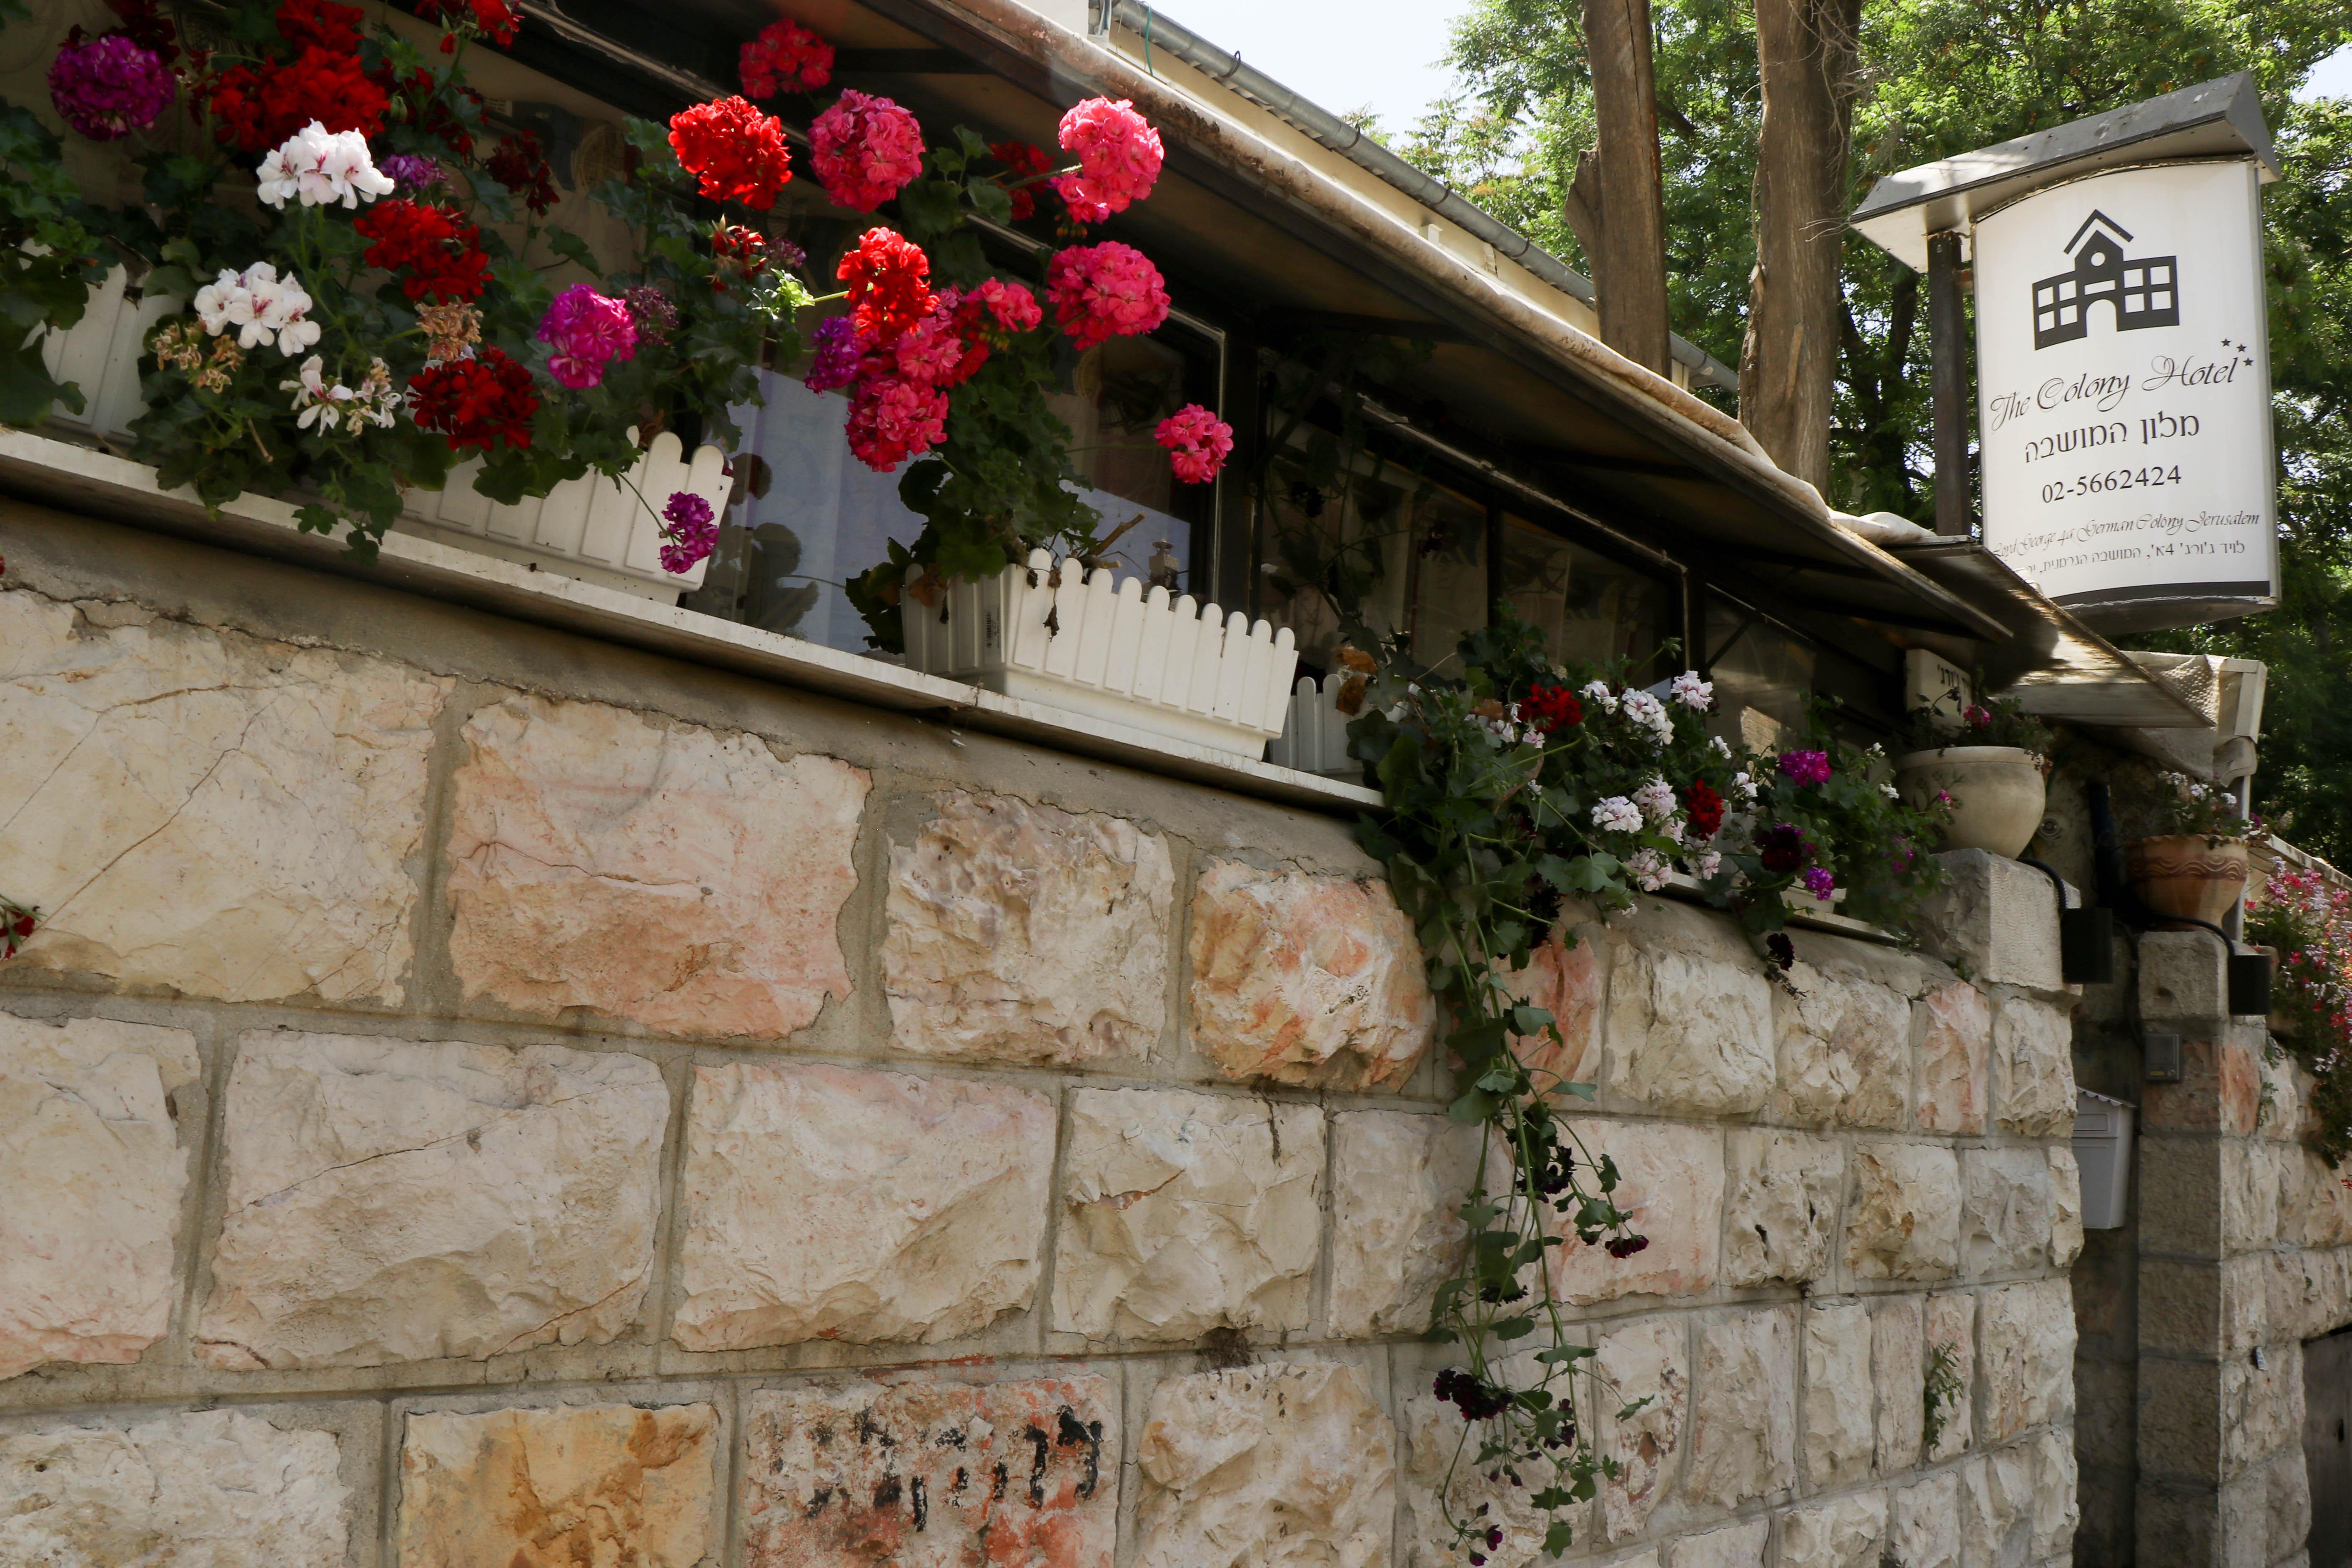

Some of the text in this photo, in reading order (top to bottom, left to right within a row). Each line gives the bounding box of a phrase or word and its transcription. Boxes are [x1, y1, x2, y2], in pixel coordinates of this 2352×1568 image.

[1990, 355, 2238, 434] The Colony Hotel
[2025, 410, 2200, 463] מלון המושבה
[2042, 465, 2182, 503] 02-5662424
[2017, 533, 2056, 556] George
[2057, 528, 2075, 546] 4a
[2076, 519, 2134, 542] German
[2136, 513, 2184, 536] Colony
[2185, 510, 2260, 532] Jerusalem
[2219, 540, 2245, 554] לויד
[2092, 548, 2141, 563] המושבה
